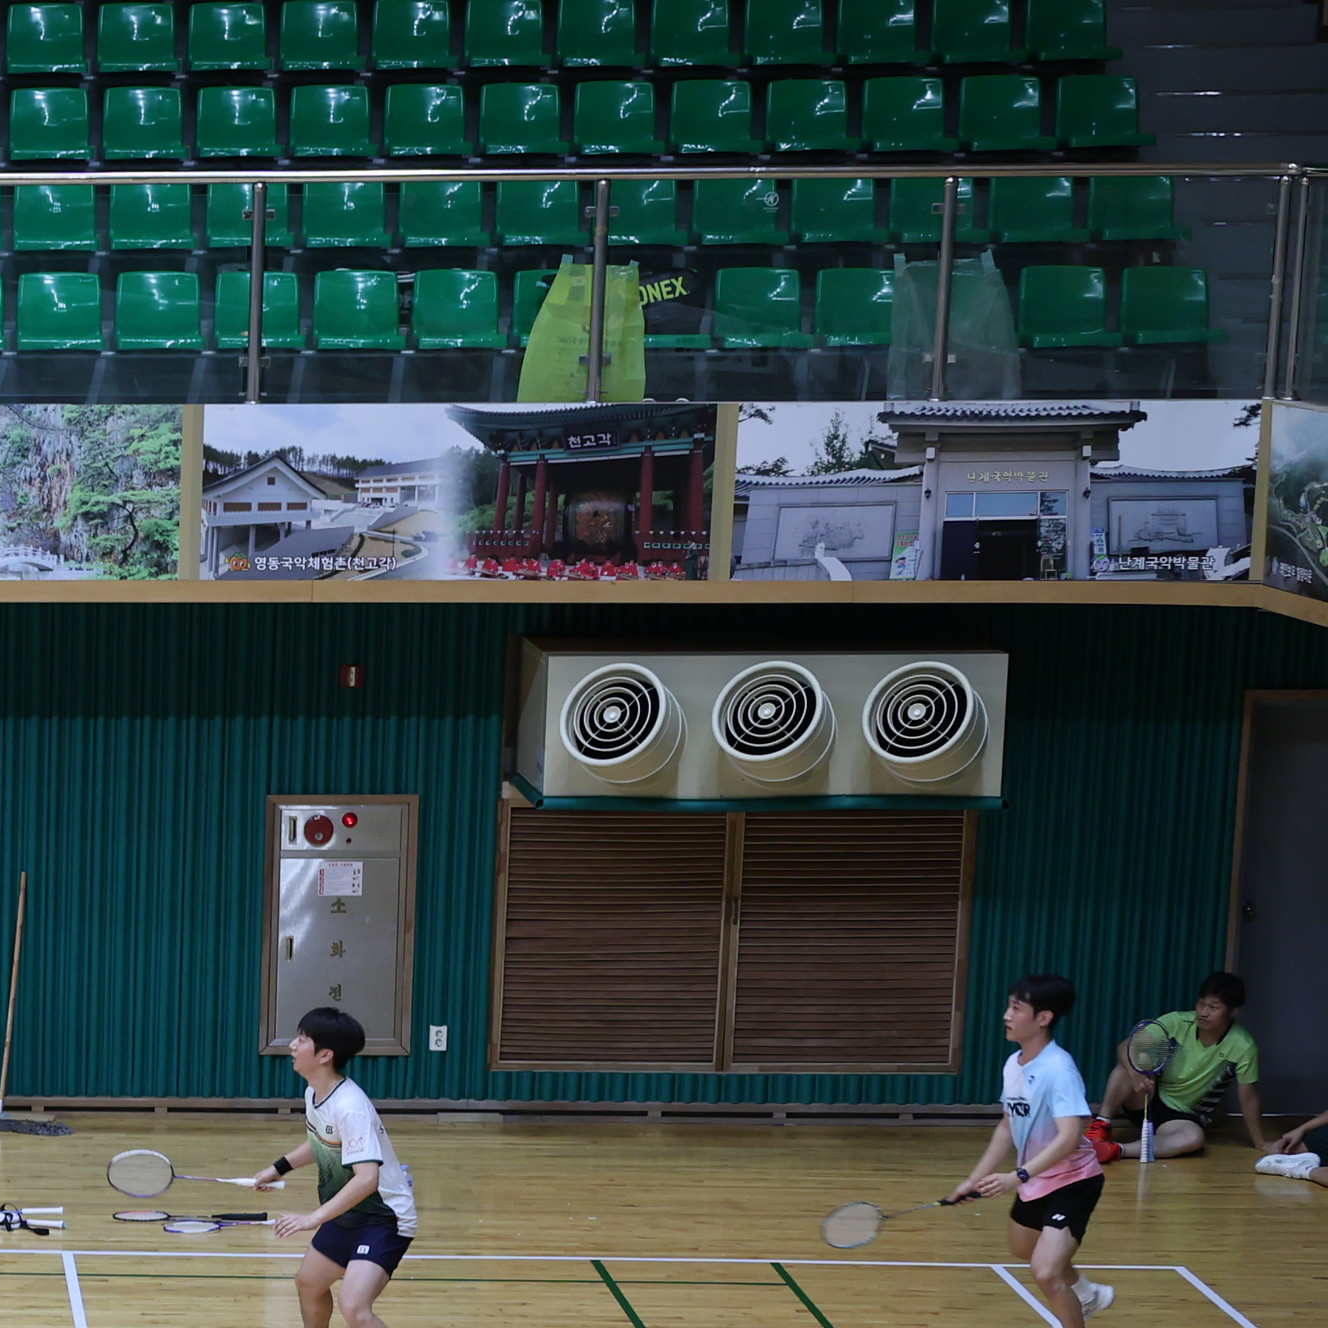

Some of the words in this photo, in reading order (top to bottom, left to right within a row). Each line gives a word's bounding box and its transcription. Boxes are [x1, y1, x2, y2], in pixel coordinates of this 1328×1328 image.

[568, 433, 612, 448] 천고각
[254, 556, 397, 571] 영동국악체험촌(천고각)
[1118, 556, 1215, 570] 난계국악박물관
